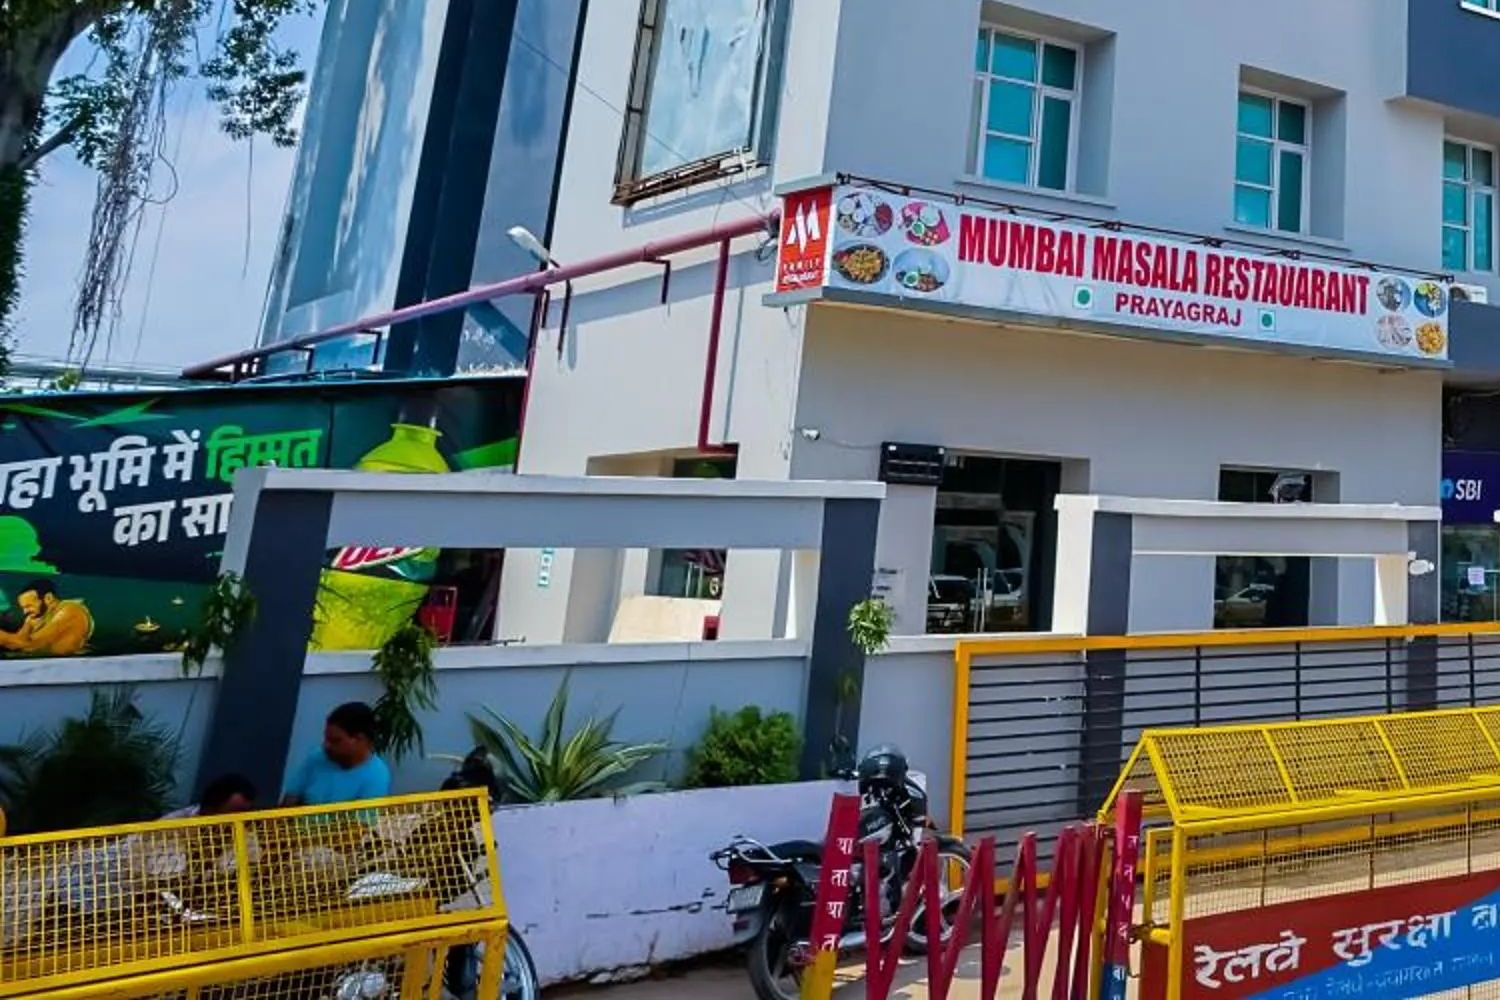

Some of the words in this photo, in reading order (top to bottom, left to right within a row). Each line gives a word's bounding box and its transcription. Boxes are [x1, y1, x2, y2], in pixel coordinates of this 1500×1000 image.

[958, 213, 1086, 277] MUMBAI
[1091, 236, 1199, 292] MASALA
[1204, 253, 1369, 315] RESTAUARANT
[1113, 291, 1243, 329] PRAYAGRAJ
[0, 456, 63, 509] हा
[69, 435, 157, 513] भूमि
[163, 429, 201, 482] में
[1455, 480, 1483, 501] SBI
[113, 499, 176, 547] का
[182, 493, 234, 538] सा
[1193, 930, 1308, 988] रेलवे
[1331, 909, 1458, 967] सुरक्षा
